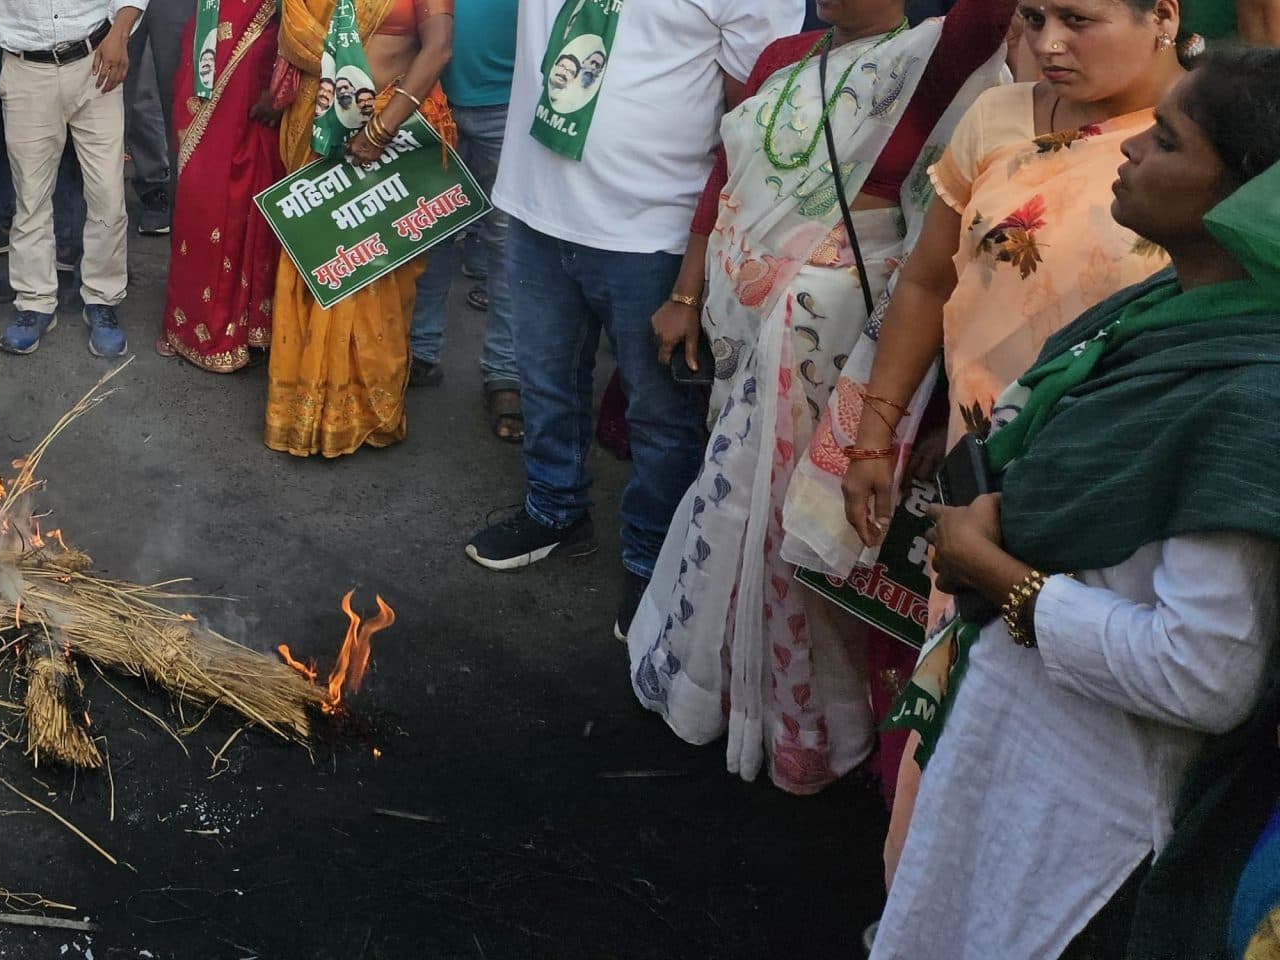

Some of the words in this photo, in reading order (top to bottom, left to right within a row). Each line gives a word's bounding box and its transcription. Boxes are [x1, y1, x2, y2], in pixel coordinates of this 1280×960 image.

[276, 163, 352, 219] महिला
[331, 172, 410, 230] भाजपा
[313, 233, 388, 289] मुर्दाबाद
[392, 183, 471, 242] मुर्दाबाद
